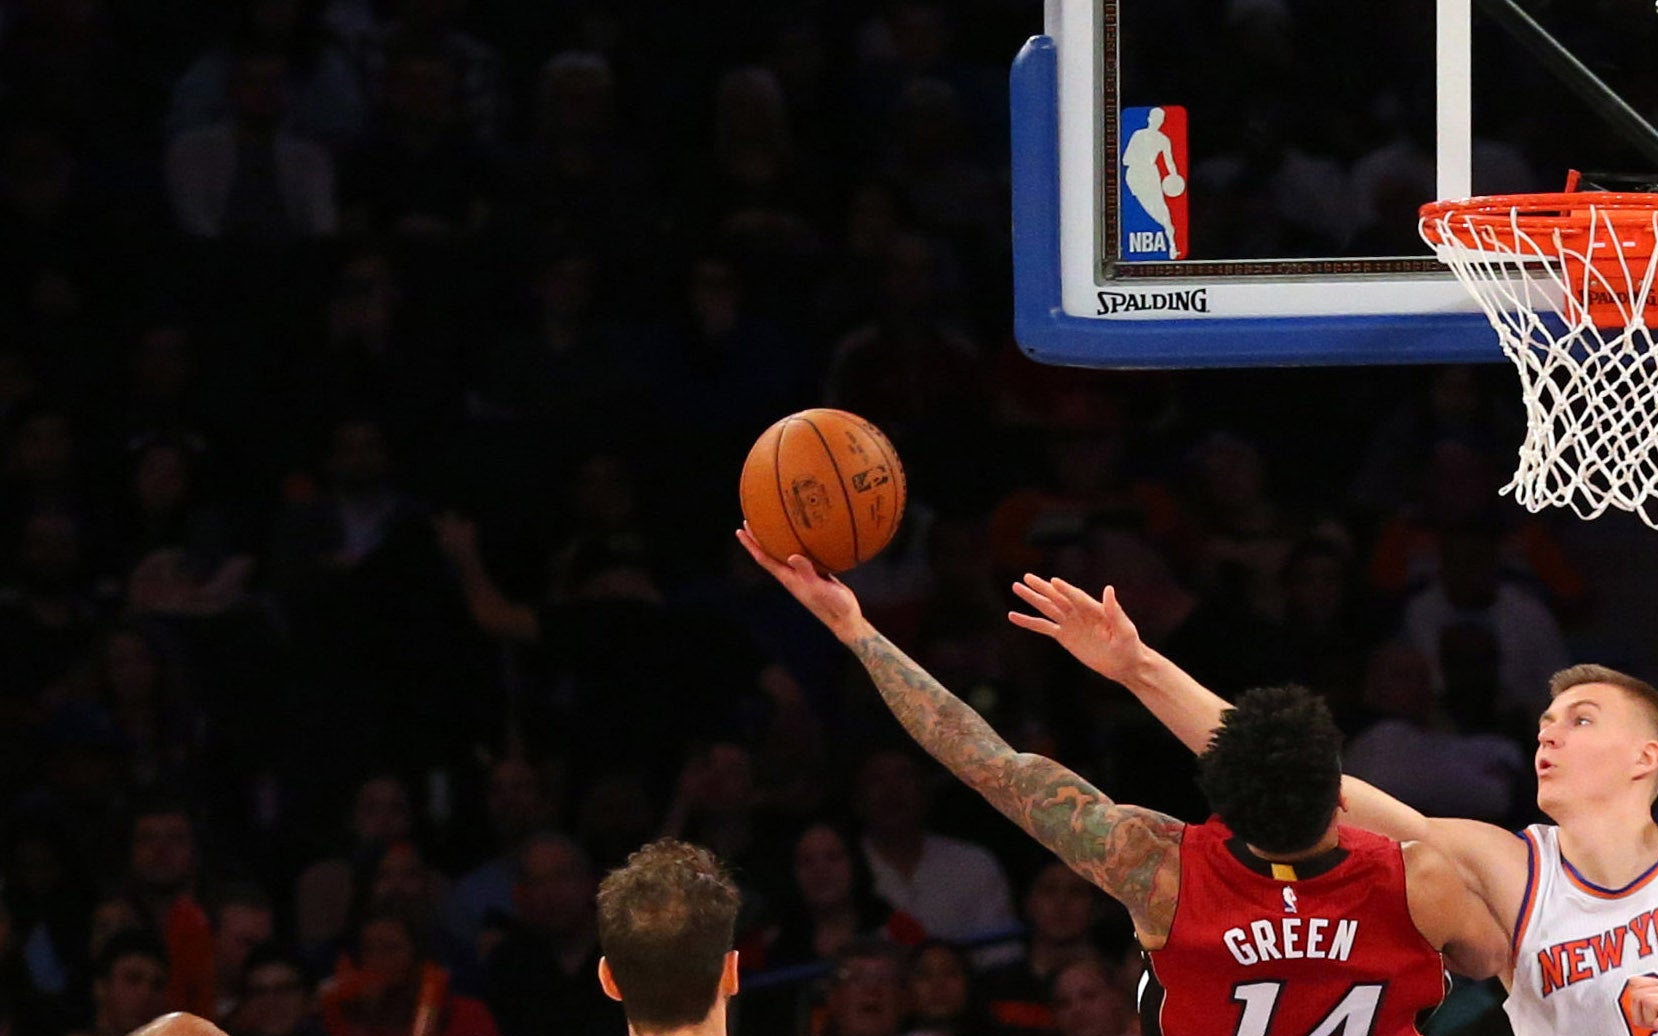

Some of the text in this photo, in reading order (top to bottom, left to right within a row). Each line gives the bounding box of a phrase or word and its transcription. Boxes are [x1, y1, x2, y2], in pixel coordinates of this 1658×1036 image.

[1129, 232, 1166, 252] NBA
[1097, 289, 1209, 315] SPALDING
[1223, 918, 1358, 966] GREEN
[1537, 924, 1628, 998] NEW
